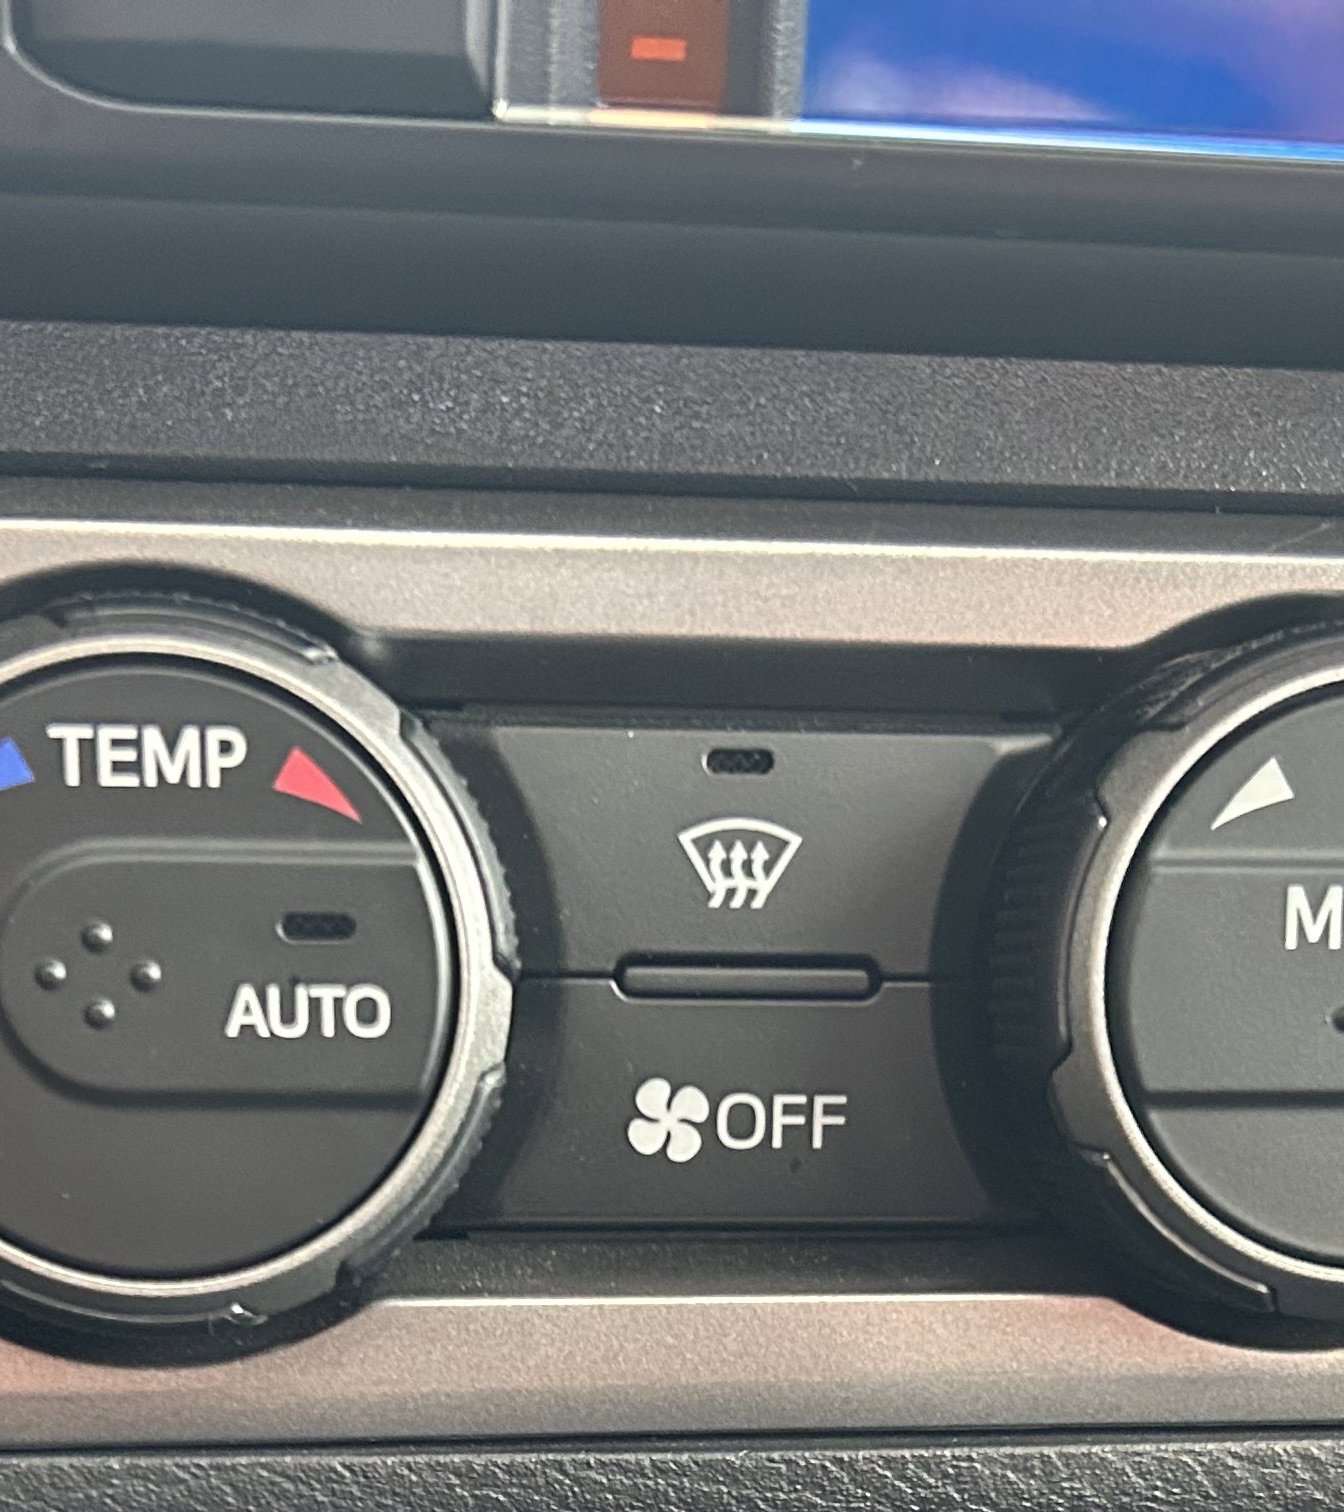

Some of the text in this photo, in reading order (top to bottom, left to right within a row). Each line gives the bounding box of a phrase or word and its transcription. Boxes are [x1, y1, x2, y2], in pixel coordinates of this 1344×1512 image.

[46, 722, 249, 789] TEMP
[224, 982, 392, 1039] AUTO
[716, 1092, 848, 1150] OFF
